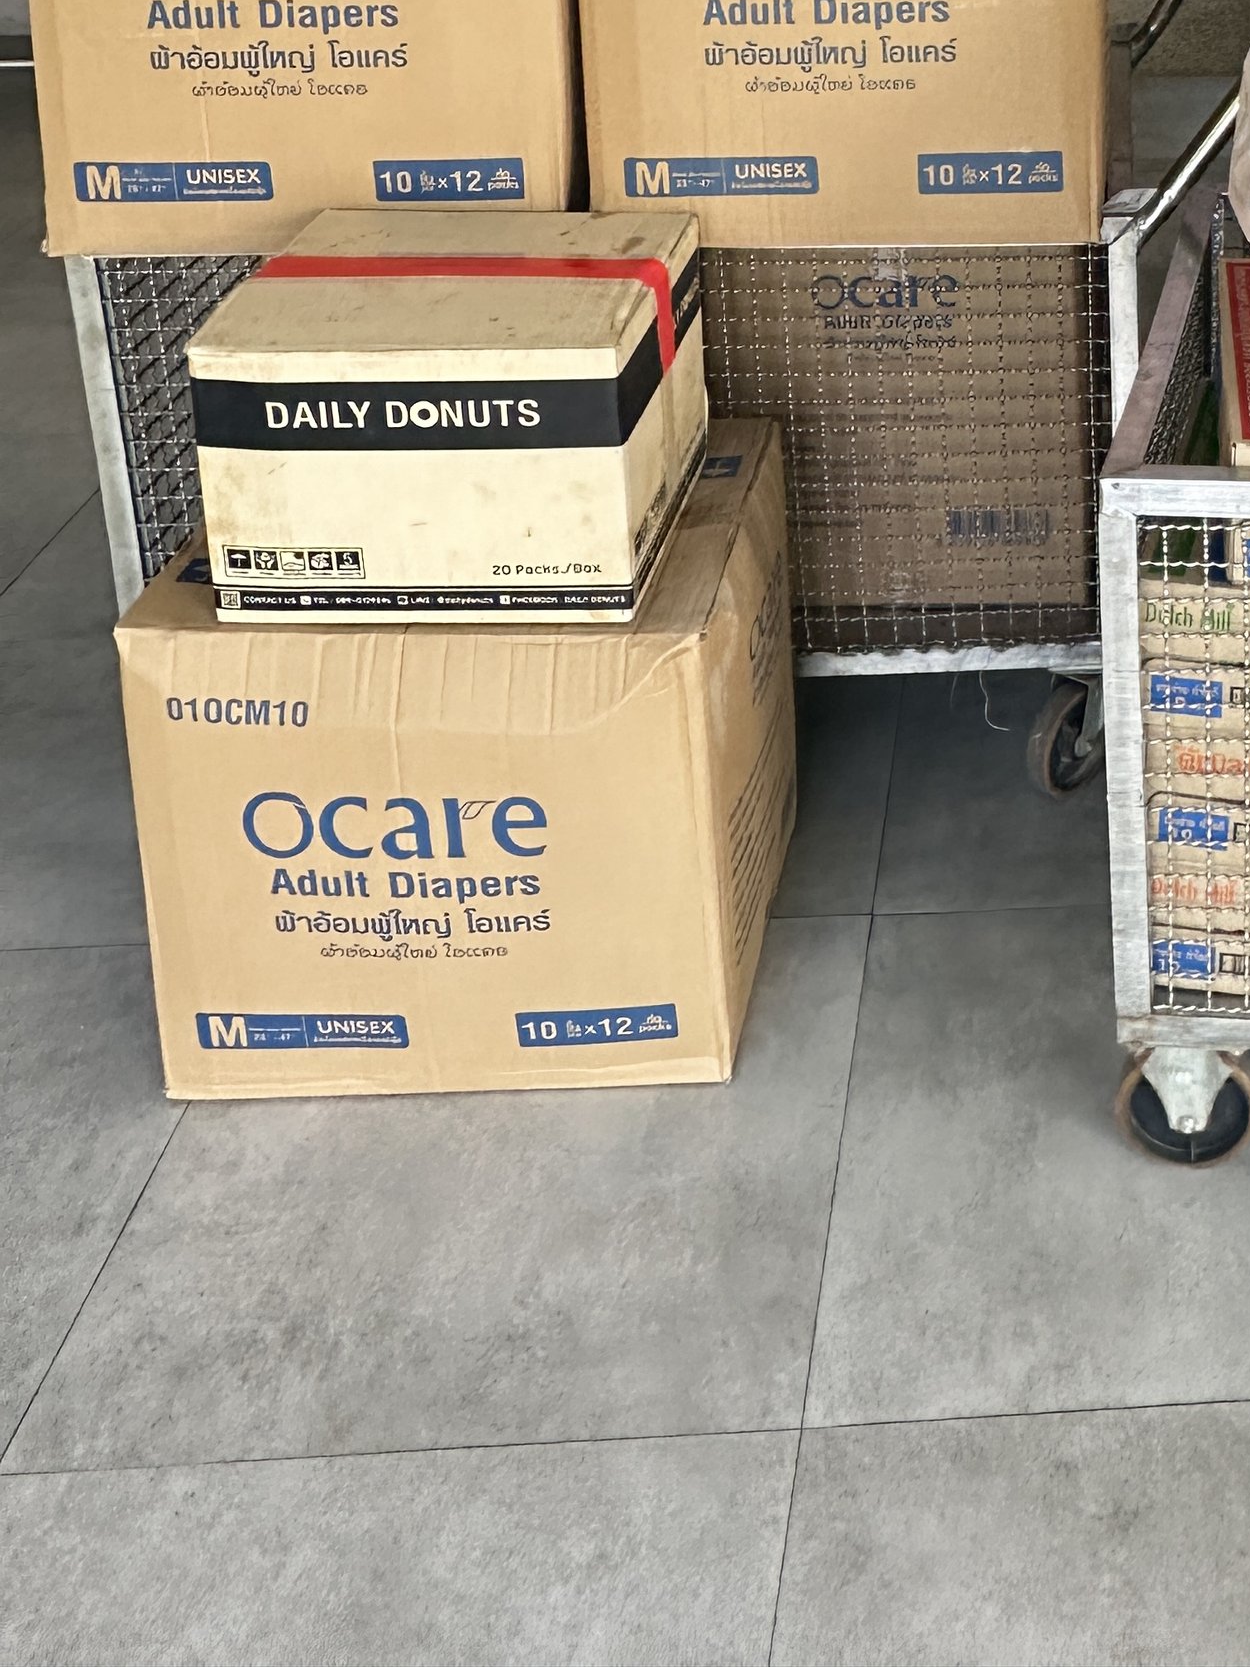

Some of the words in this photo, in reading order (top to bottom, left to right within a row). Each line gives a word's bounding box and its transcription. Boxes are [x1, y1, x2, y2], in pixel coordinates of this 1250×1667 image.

[148, 0, 240, 29] Adult
[150, 40, 316, 77] ผ้าอ้อมผู้ใหญ่
[329, 41, 409, 70] โอแคร์
[704, 36, 867, 72] ผ้าอ้อมผู้ใหญ่
[880, 37, 958, 64] โอแคร์
[86, 165, 121, 200] M
[187, 167, 262, 186] UNISEX
[380, 170, 413, 193] 10
[635, 161, 671, 195] M
[735, 163, 808, 180] UNISEX
[923, 164, 954, 186] 10
[265, 400, 371, 429] DAILY
[386, 398, 541, 428] DONUTS
[492, 564, 511, 576] 20
[271, 870, 370, 898] Adult
[389, 871, 541, 905] Diapers
[275, 909, 452, 943] ผ้าอ้อมผู้ใหญ่
[465, 908, 552, 935] โอแคร์
[207, 1016, 250, 1047] M
[317, 1020, 396, 1035] UNISEX
[521, 1020, 557, 1041] 10
